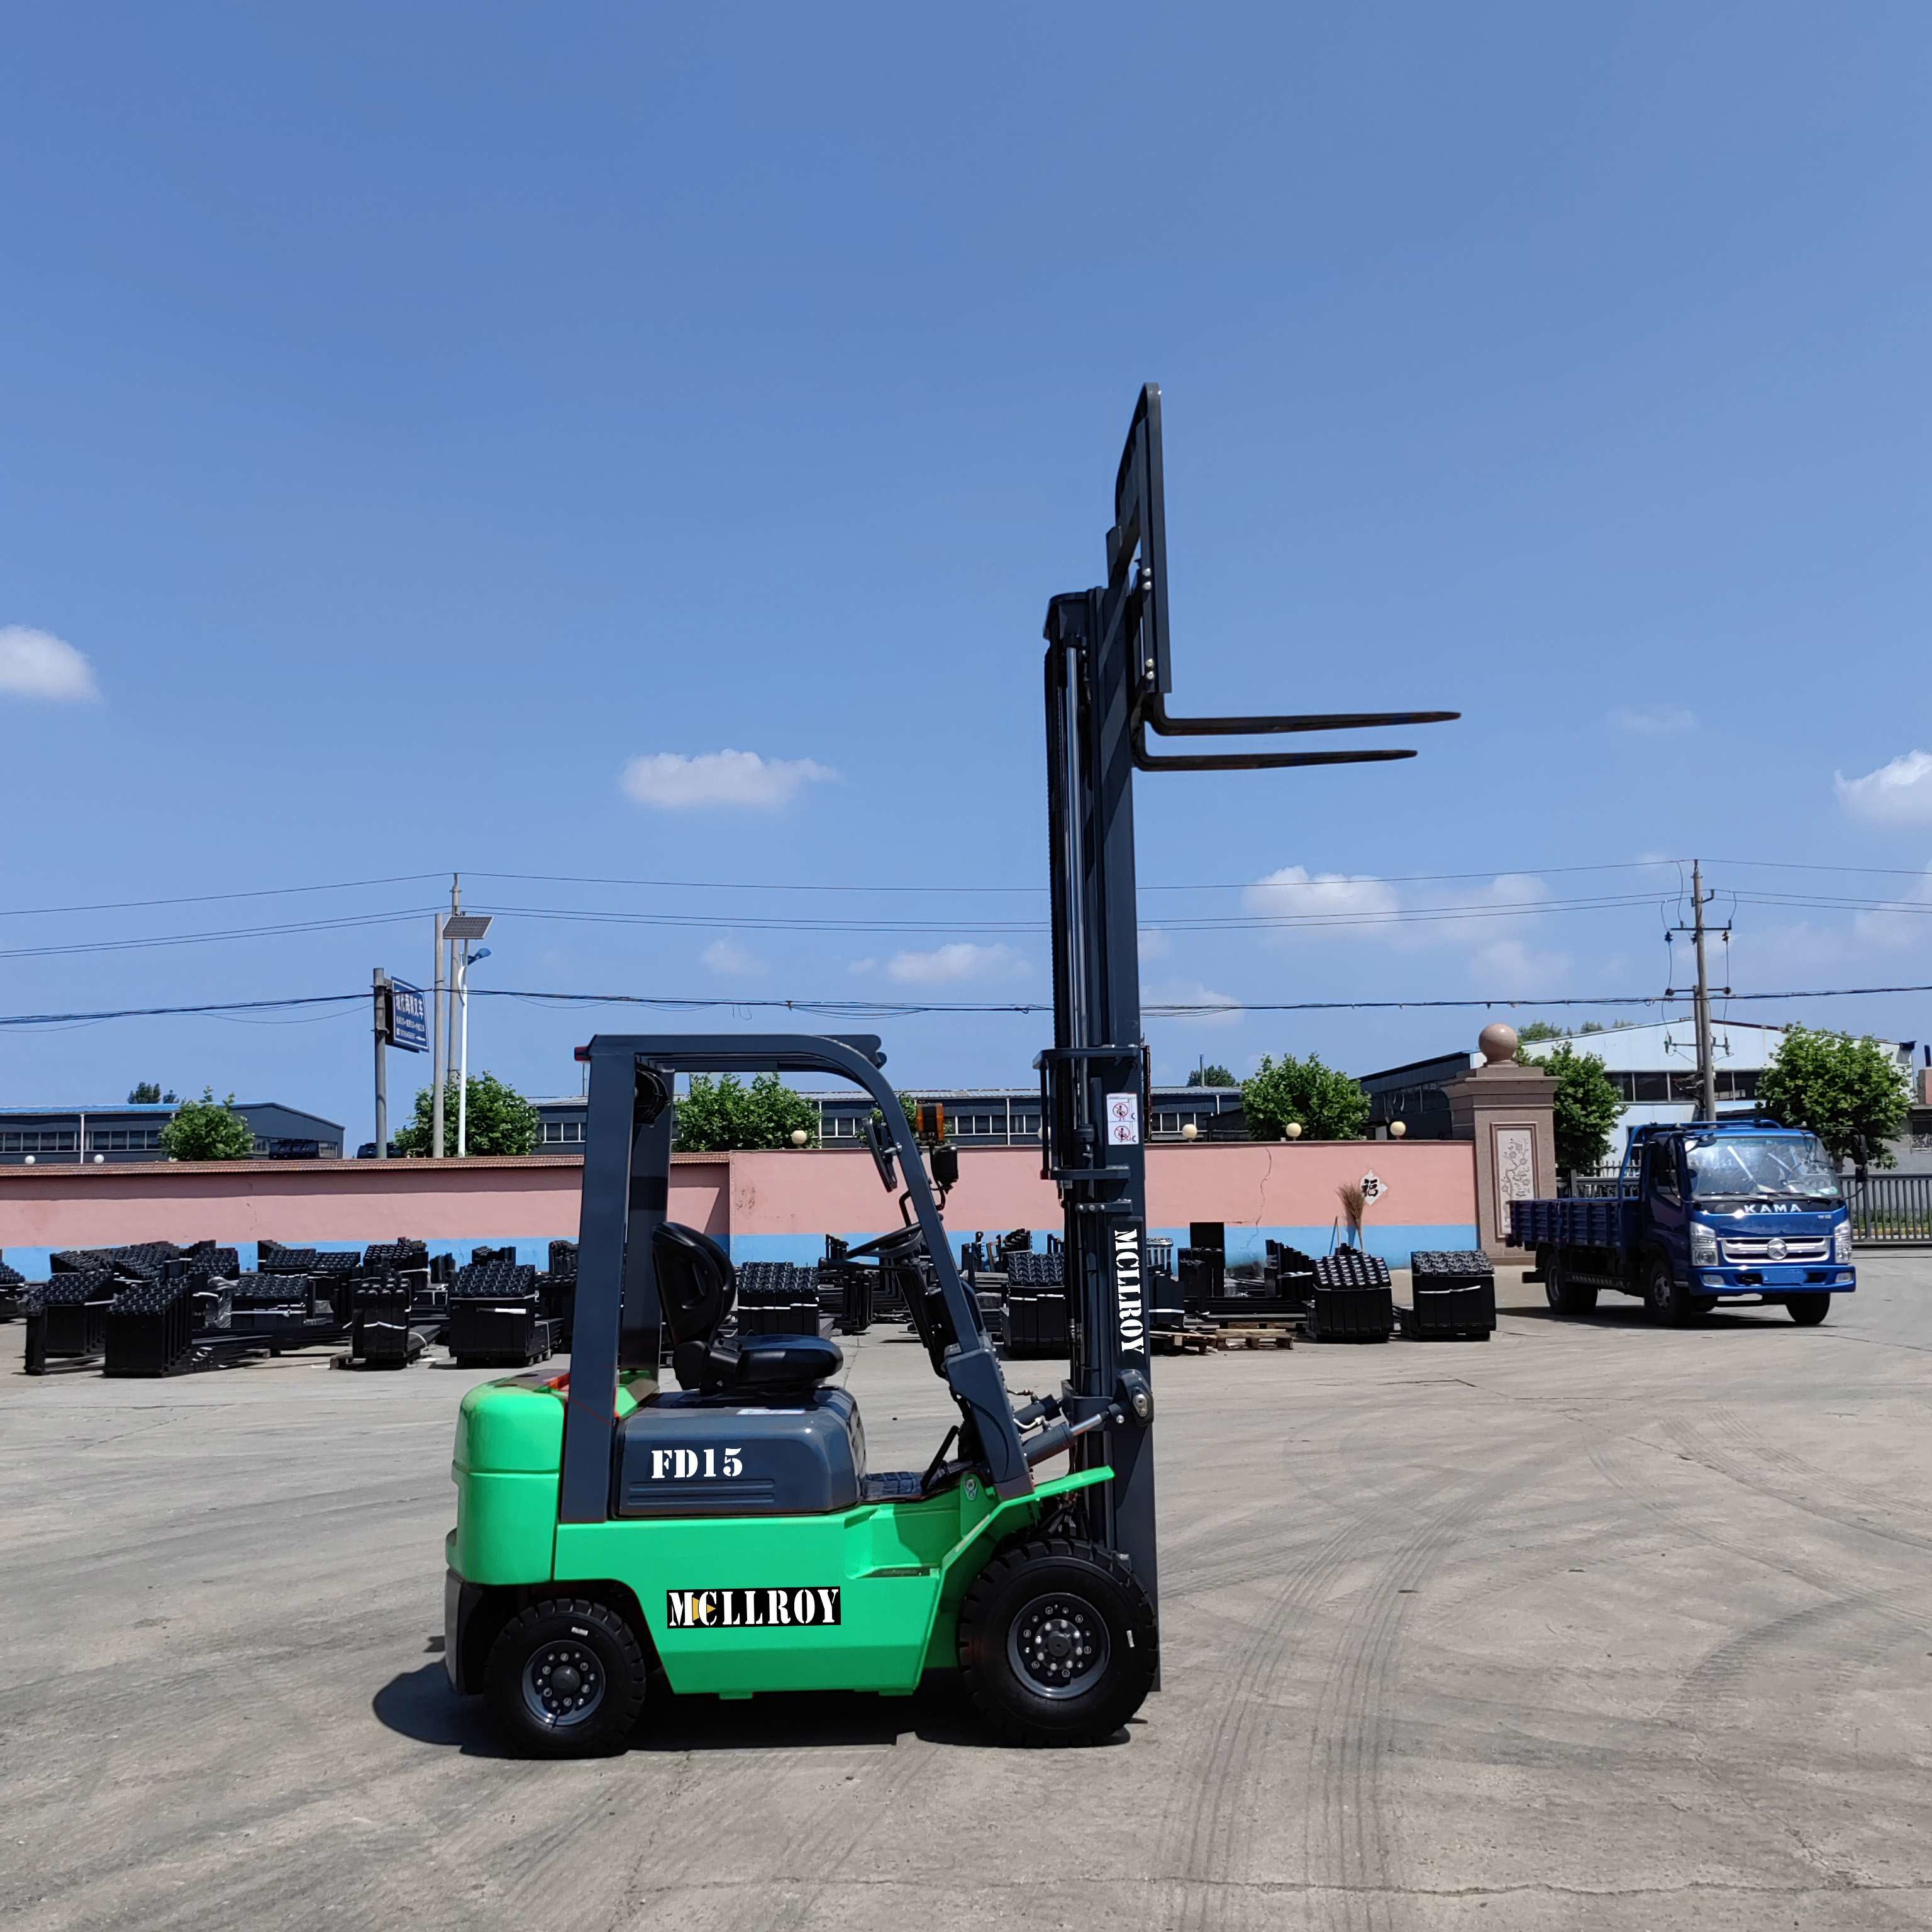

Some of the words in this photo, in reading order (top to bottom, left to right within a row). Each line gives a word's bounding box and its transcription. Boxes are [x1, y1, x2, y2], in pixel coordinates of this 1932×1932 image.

[1362, 1178, 1379, 1197] 福
[1743, 1204, 1802, 1213] KAMA
[652, 1448, 743, 1479] FD15
[669, 1589, 839, 1626] MCLLROY
